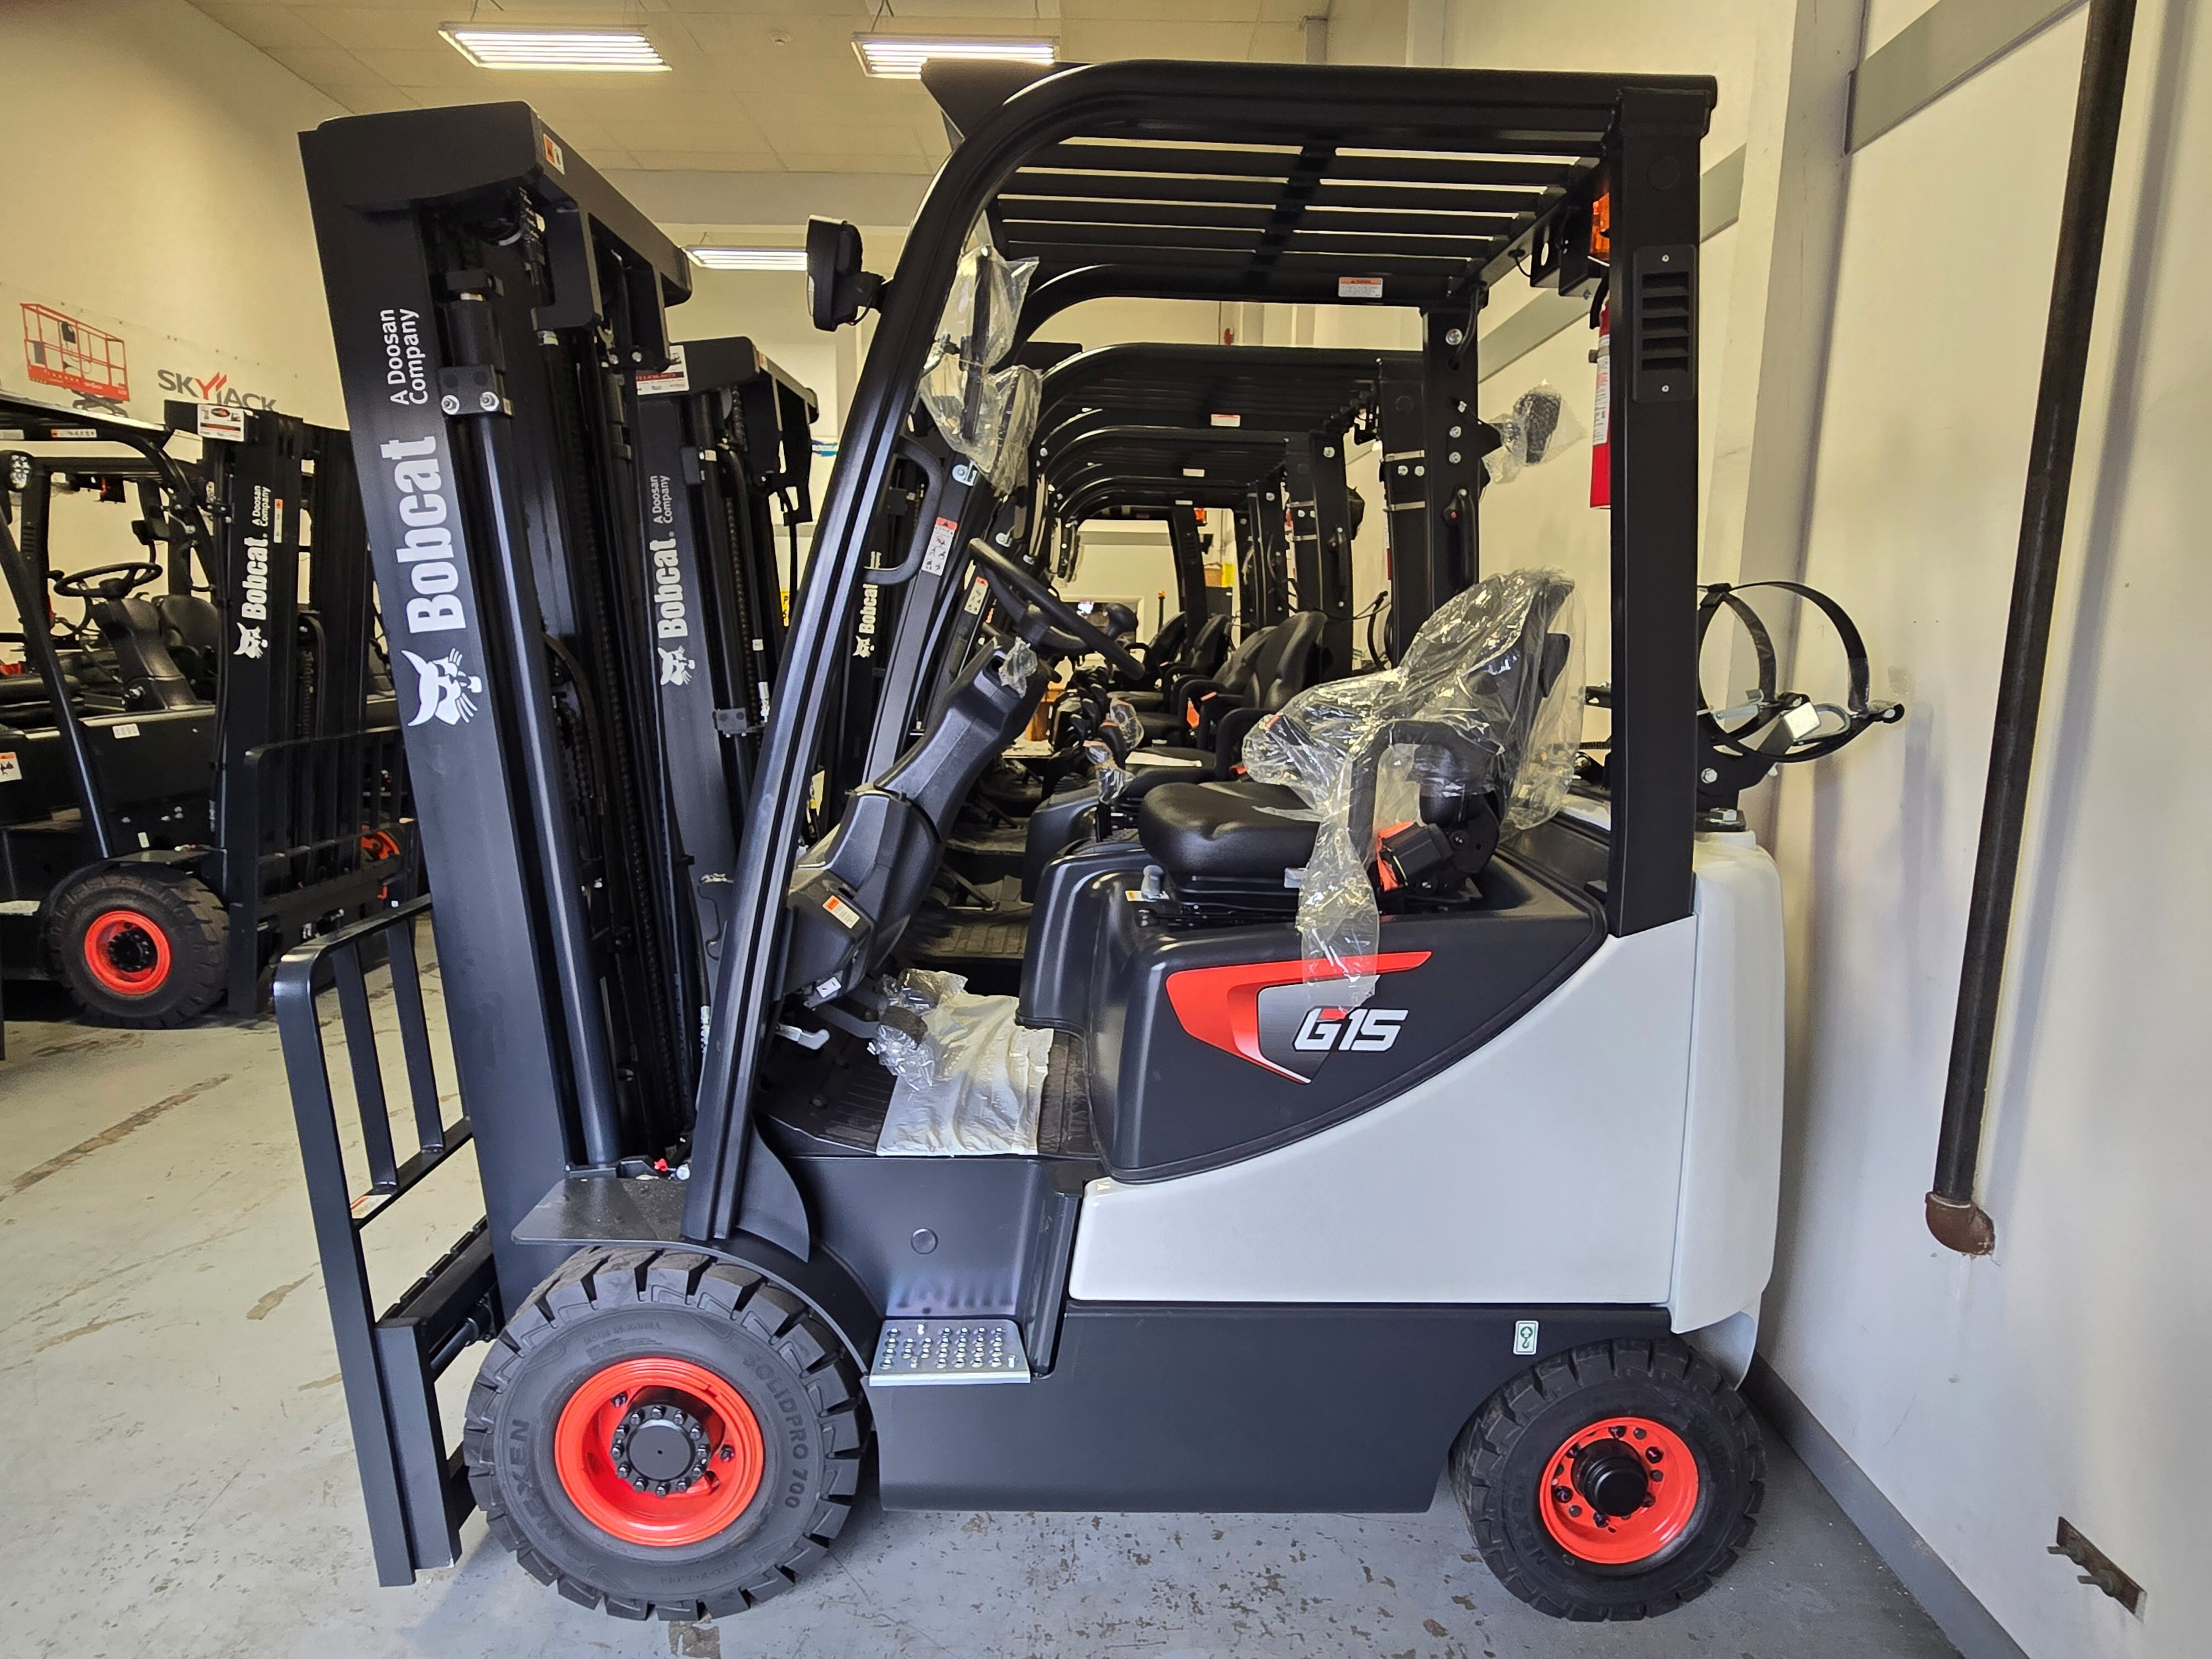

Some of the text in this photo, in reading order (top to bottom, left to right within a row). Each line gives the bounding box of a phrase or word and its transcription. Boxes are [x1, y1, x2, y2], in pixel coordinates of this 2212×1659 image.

[380, 309, 409, 405] A Doosan
[400, 309, 428, 405] Company
[252, 486, 261, 518] Doosan
[261, 487, 271, 527] Company
[380, 436, 466, 634] Bobcat
[650, 476, 663, 524] A Doosan
[660, 475, 673, 524] Company
[242, 537, 268, 620] Bobcat
[650, 539, 688, 639] Bobcat
[1293, 1008, 1409, 1051] G15
[743, 1354, 809, 1509] SOLIDPRO 700
[510, 1418, 564, 1542] NEXEN
